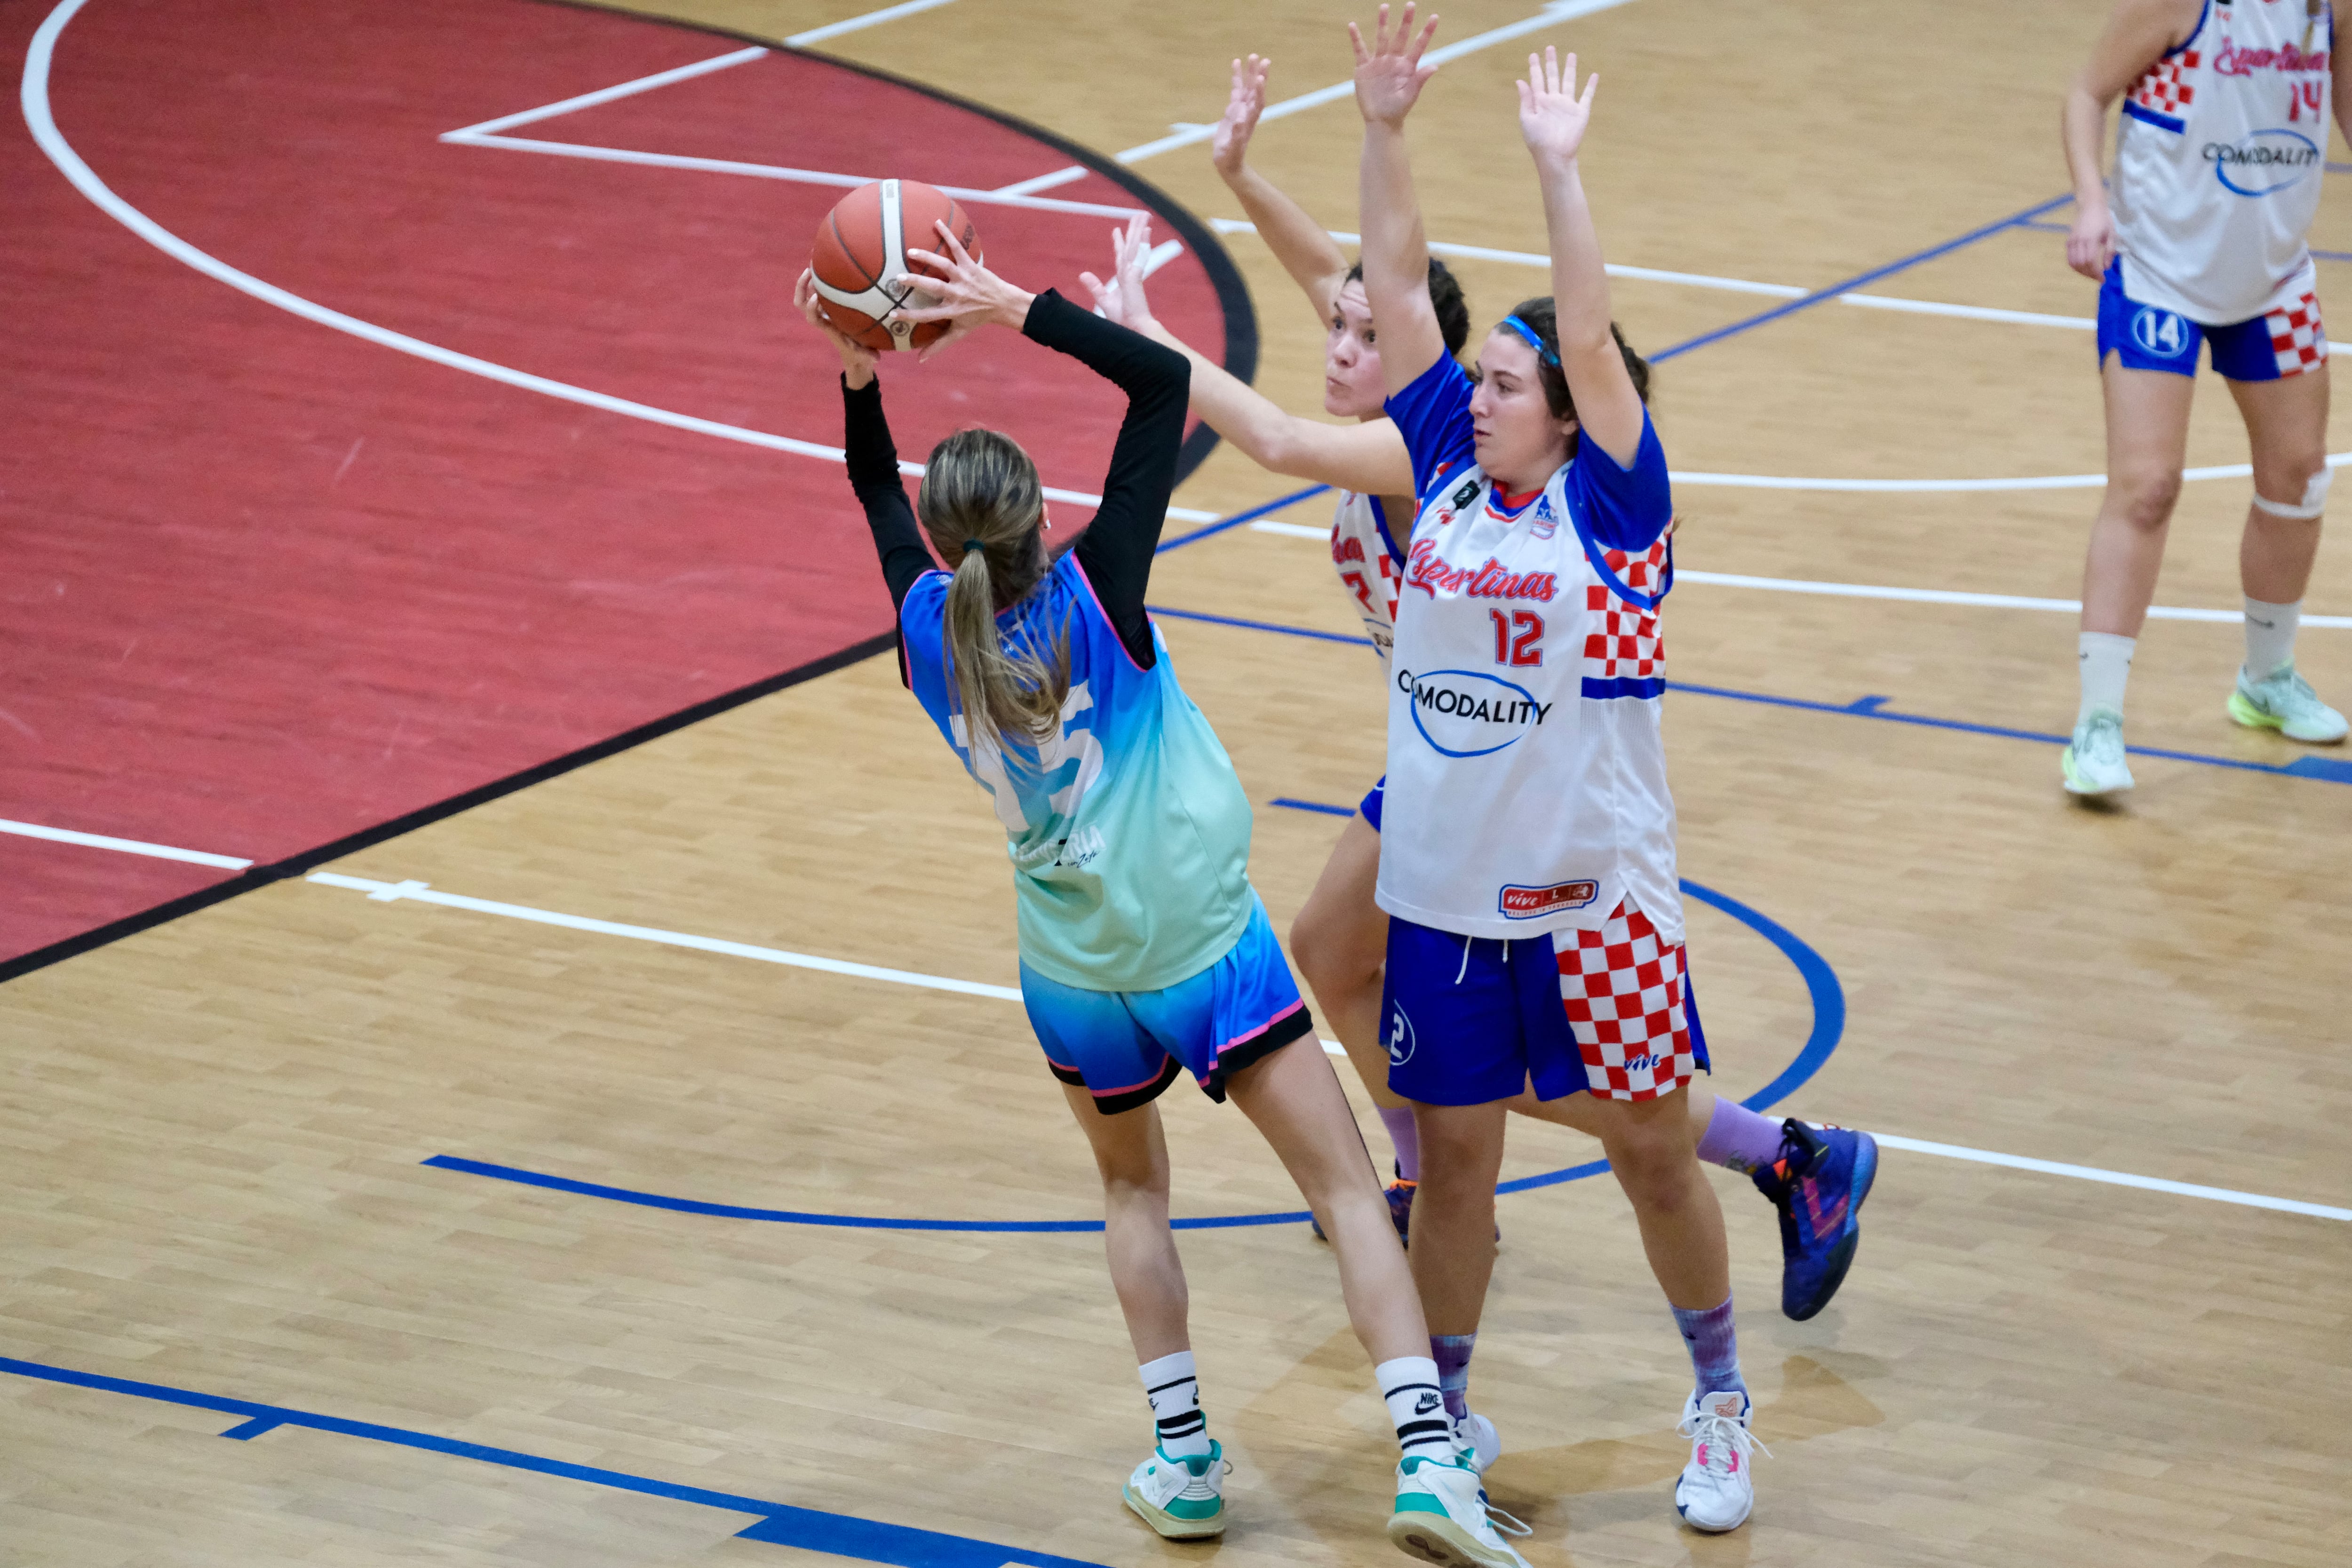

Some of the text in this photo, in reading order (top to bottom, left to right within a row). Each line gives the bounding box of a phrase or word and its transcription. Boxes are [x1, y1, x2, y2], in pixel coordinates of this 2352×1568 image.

[2288, 81, 2322, 124] 14
[2145, 311, 2180, 351] 14
[1489, 608, 1545, 667] 12
[1420, 1393, 1438, 1405] NIKE
